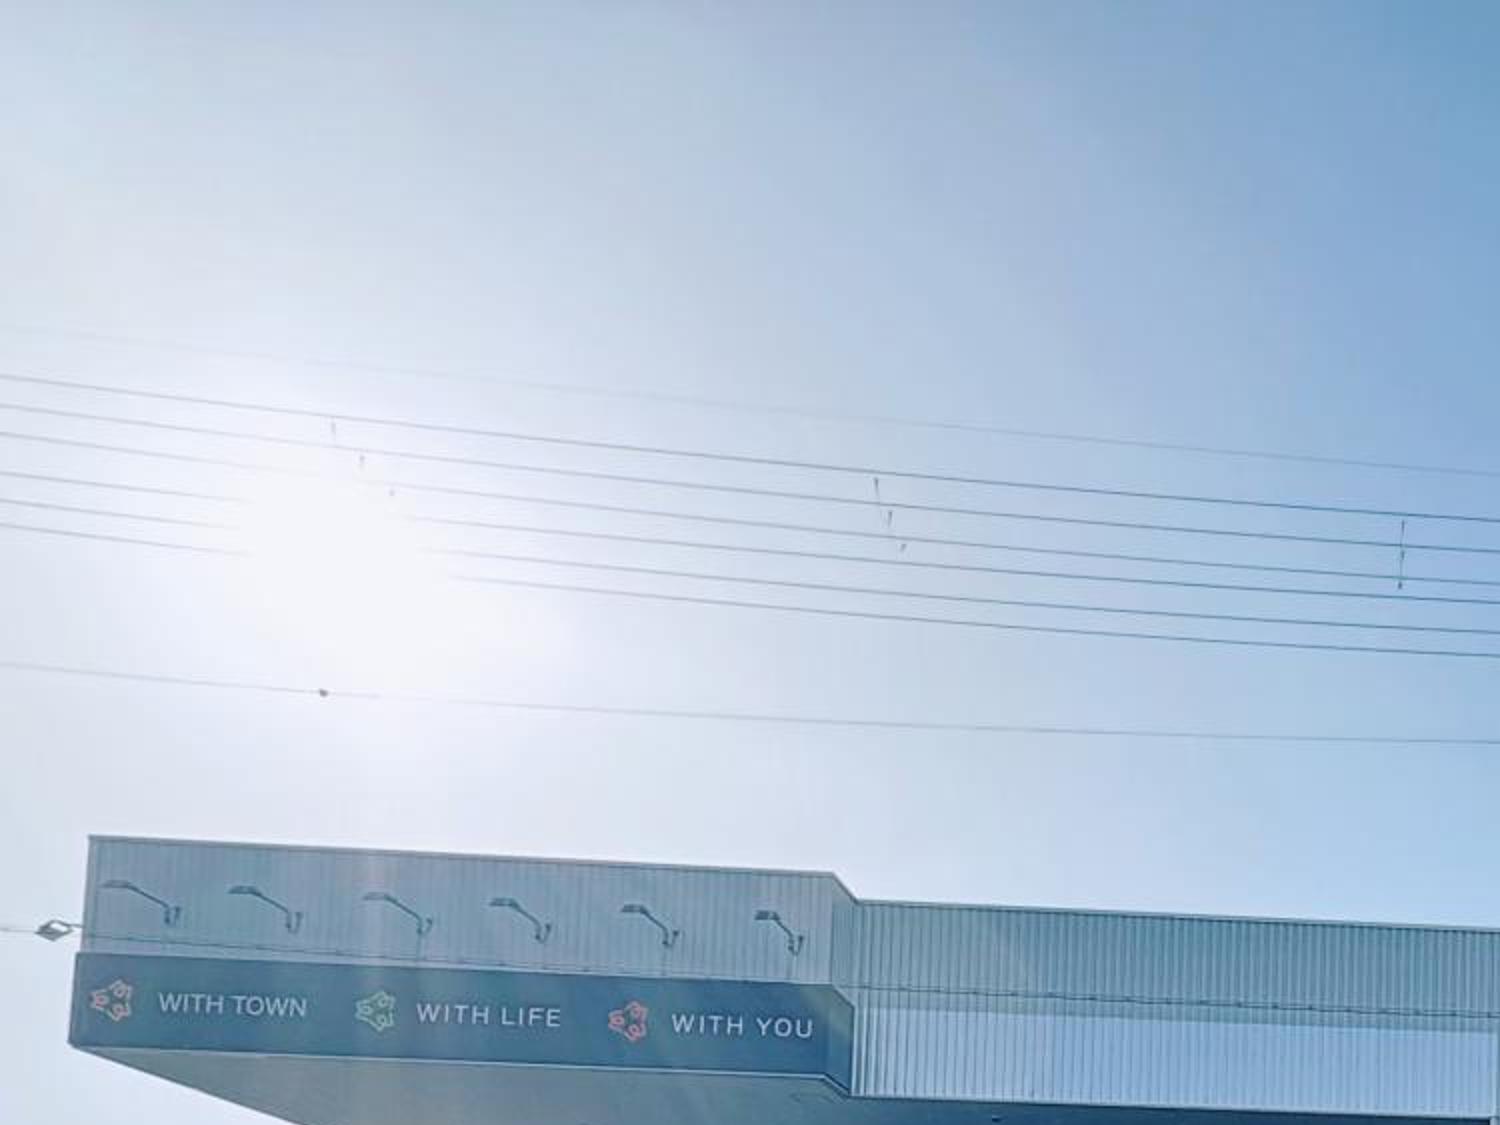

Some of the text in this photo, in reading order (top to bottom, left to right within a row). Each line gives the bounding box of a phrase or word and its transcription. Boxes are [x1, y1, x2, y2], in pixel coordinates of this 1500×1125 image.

[158, 991, 308, 1017] WITH TOWN
[416, 1003, 561, 1027] WITH LIFE
[671, 1013, 813, 1039] WITH YOU
